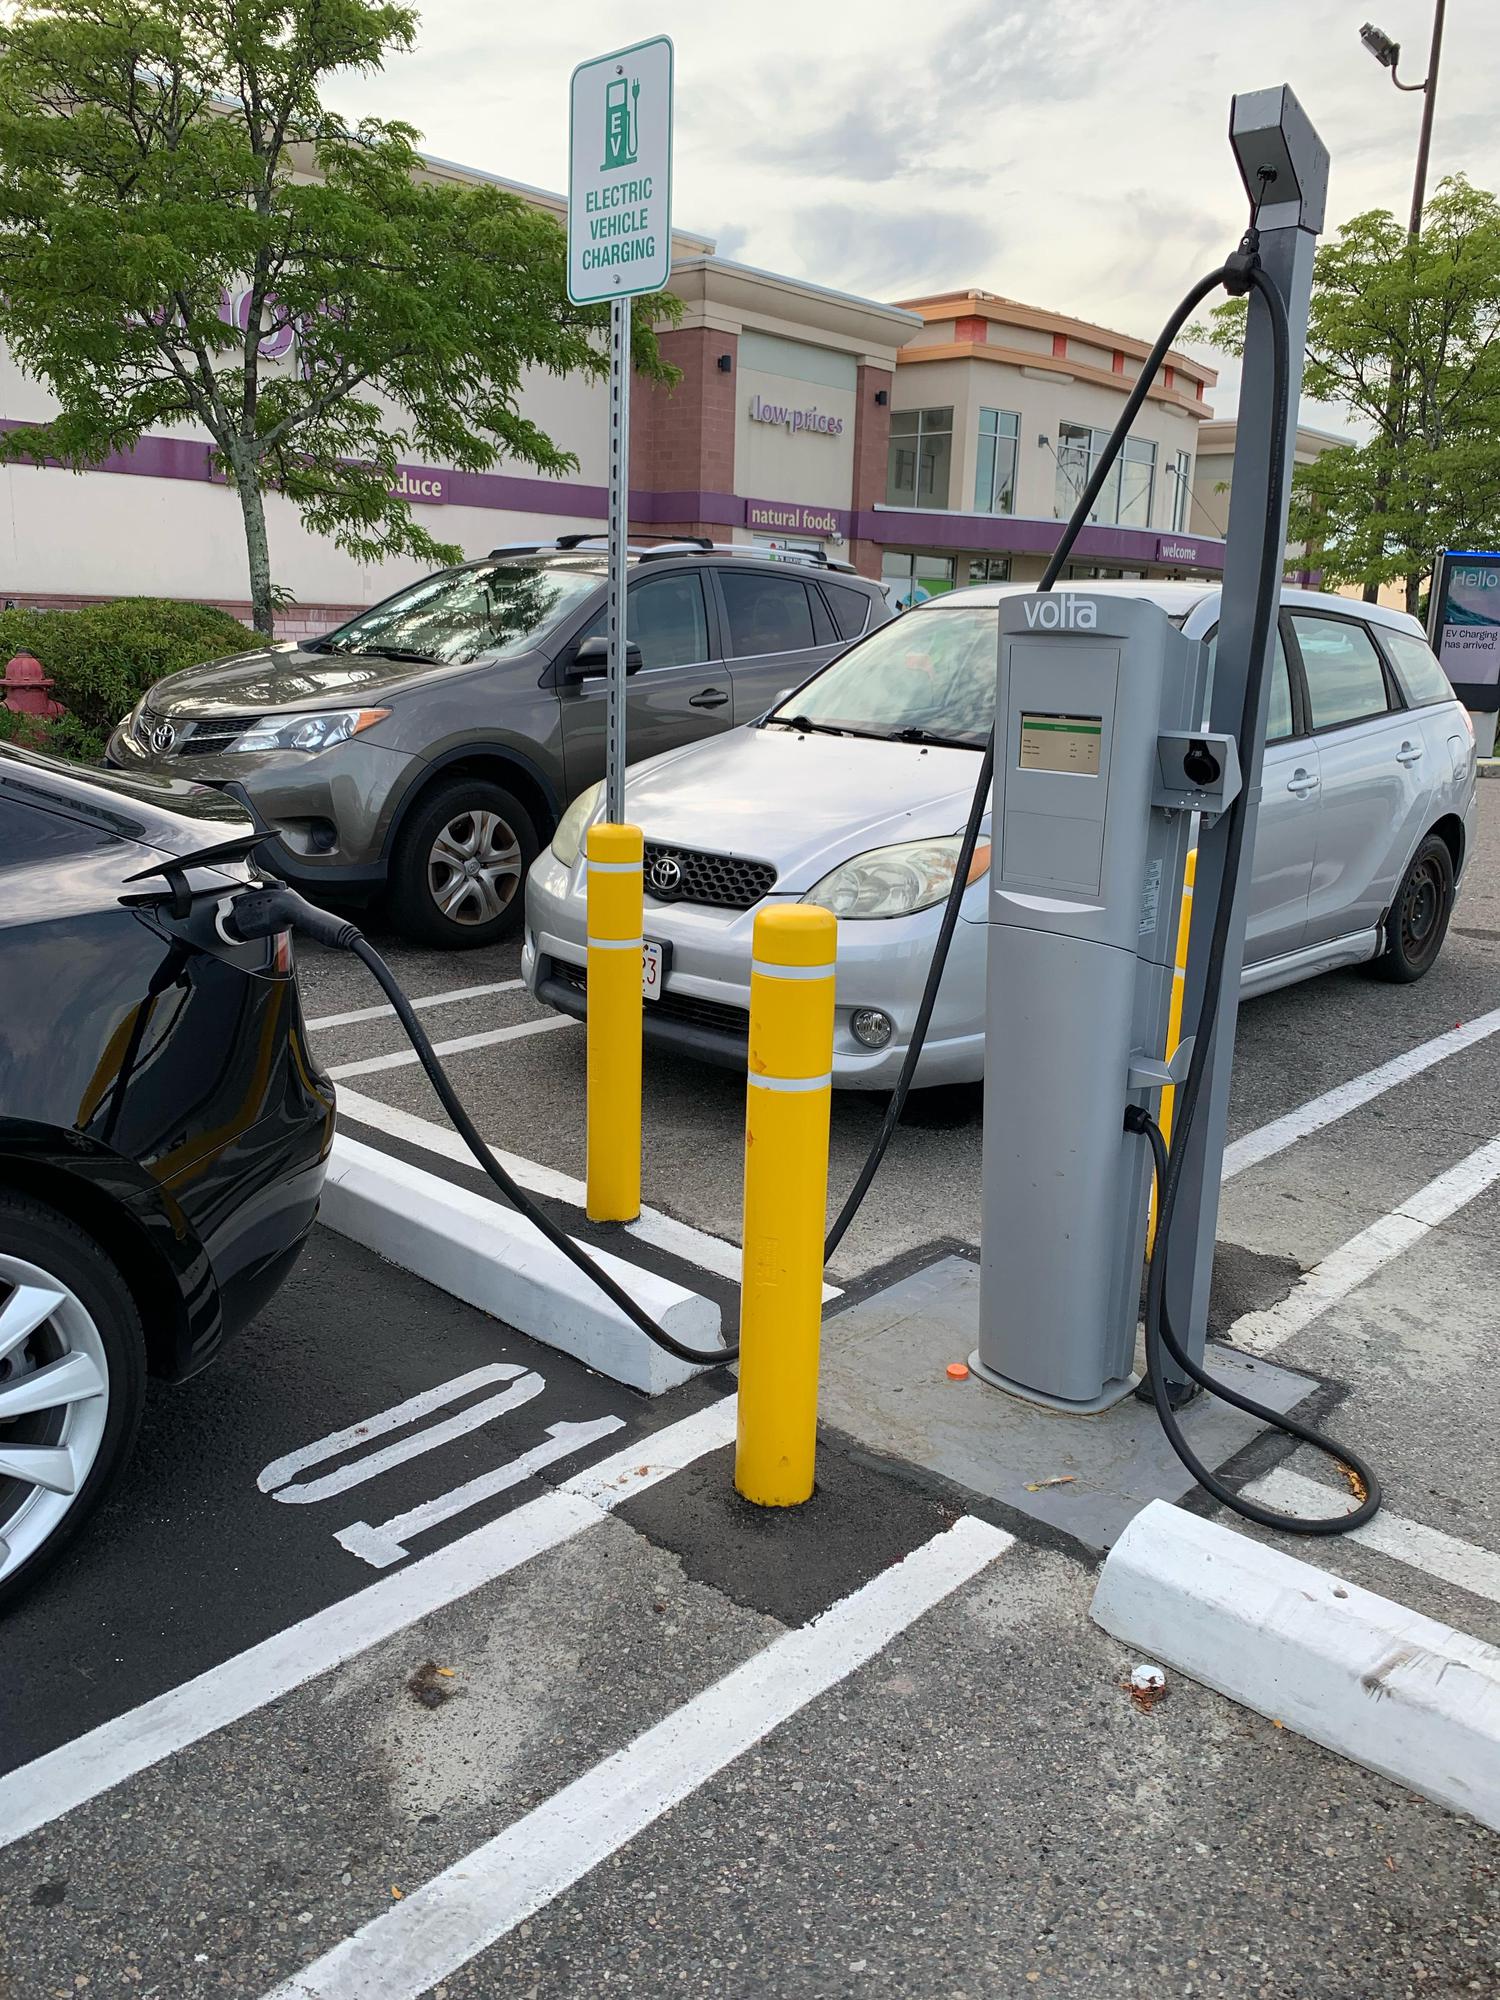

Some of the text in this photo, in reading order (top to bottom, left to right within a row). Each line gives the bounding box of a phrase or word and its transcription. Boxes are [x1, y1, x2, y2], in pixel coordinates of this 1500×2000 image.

[586, 177, 653, 213] ELECTRIC
[590, 208, 648, 240] VEHICLE
[582, 236, 655, 270] CHARGING
[752, 395, 843, 435] low prices
[752, 509, 837, 532] natural foods
[1162, 542, 1196, 560] welcome
[1453, 570, 1498, 588] Hello
[1023, 593, 1097, 629] volta
[1444, 640, 1496, 650] has arrived.
[1445, 629, 1498, 641] EV Charging
